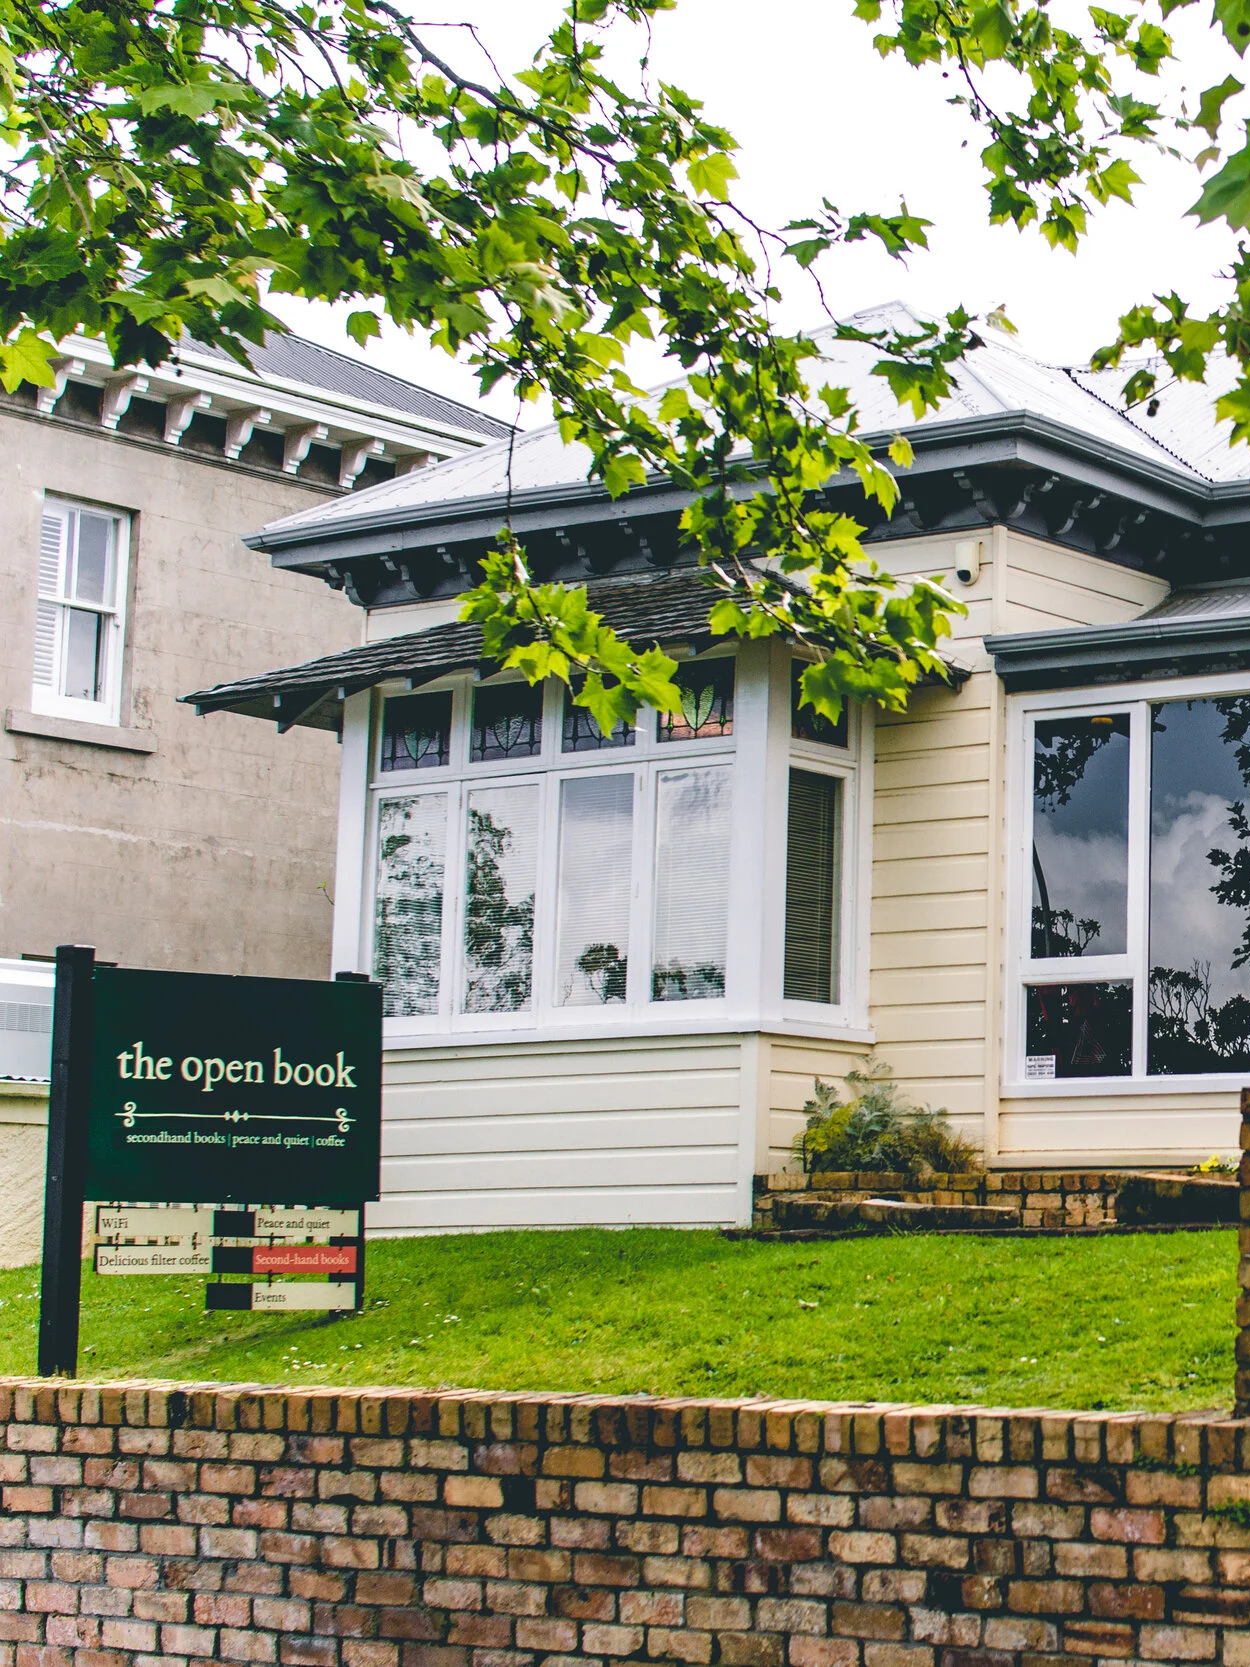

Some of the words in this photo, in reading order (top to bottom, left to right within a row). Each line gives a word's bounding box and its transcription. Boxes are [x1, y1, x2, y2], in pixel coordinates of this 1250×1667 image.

[116, 1040, 173, 1080] the
[180, 1056, 265, 1092] open
[273, 1047, 358, 1088] book
[126, 1130, 192, 1144] secondhand
[193, 1132, 226, 1144] books
[232, 1135, 260, 1148] peace
[261, 1133, 281, 1145] and
[283, 1135, 309, 1149] quiet
[315, 1135, 346, 1147] coffee
[101, 1217, 129, 1229] WiFi
[256, 1217, 284, 1229] Peace
[285, 1217, 305, 1229] and
[306, 1219, 331, 1232] quiet
[99, 1254, 149, 1267] Delicious
[150, 1254, 178, 1266] filter
[179, 1253, 210, 1265] coffee
[255, 1253, 319, 1266] Second-hand
[320, 1253, 350, 1265] books
[254, 1292, 287, 1303] Events
